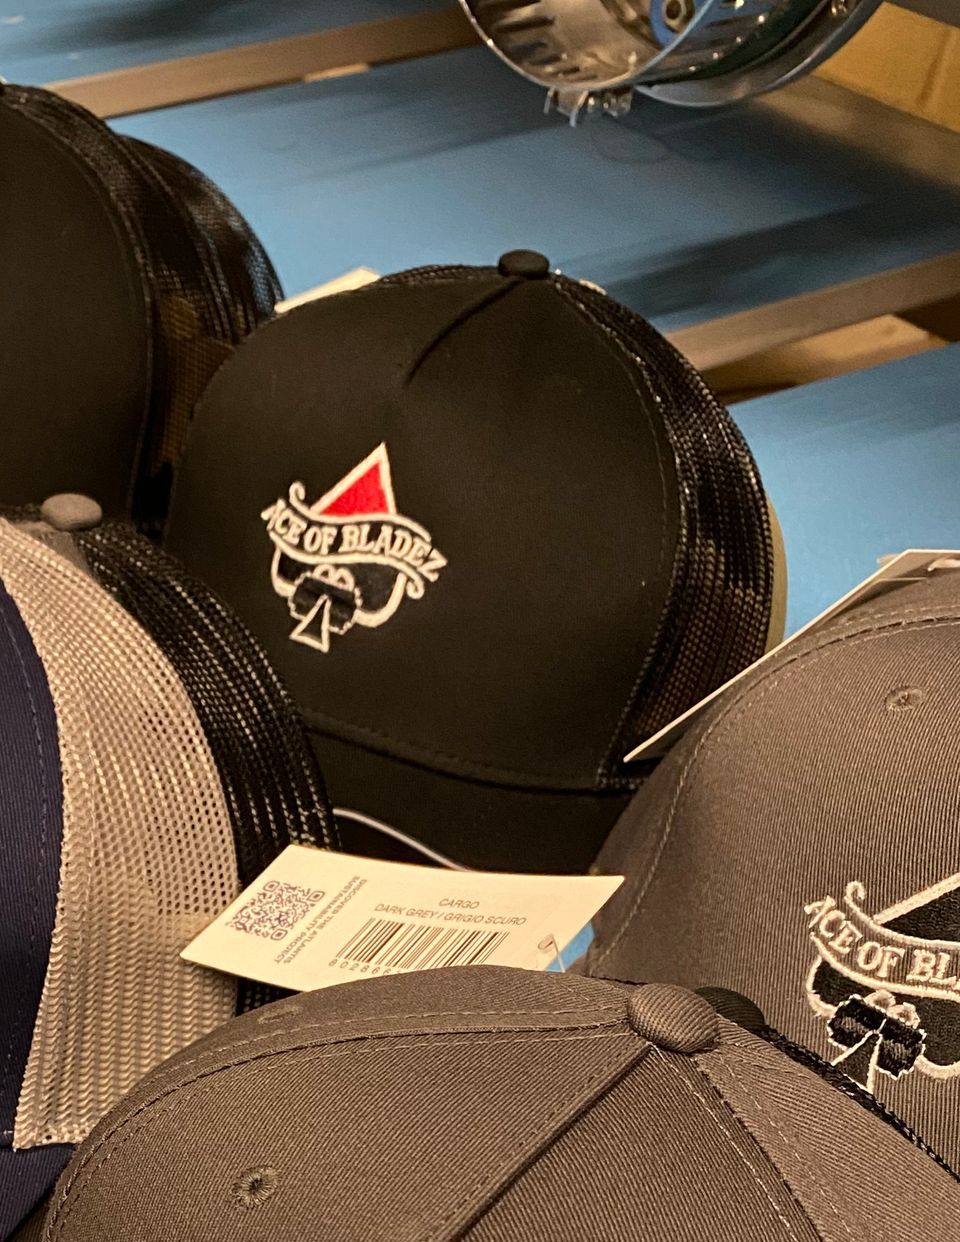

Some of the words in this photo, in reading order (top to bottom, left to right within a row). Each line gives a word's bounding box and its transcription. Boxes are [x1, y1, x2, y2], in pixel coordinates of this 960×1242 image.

[261, 498, 306, 546] ACE
[304, 525, 337, 554] OF
[338, 524, 448, 582] BLADEZ
[374, 903, 406, 915] DARK
[406, 908, 438, 919] GREY
[444, 913, 484, 923] GRIGIO
[485, 916, 527, 926] SCURO
[438, 898, 480, 909] CARGO
[804, 896, 863, 954] ACE
[857, 941, 906, 978] OF
[906, 949, 960, 991] BL
